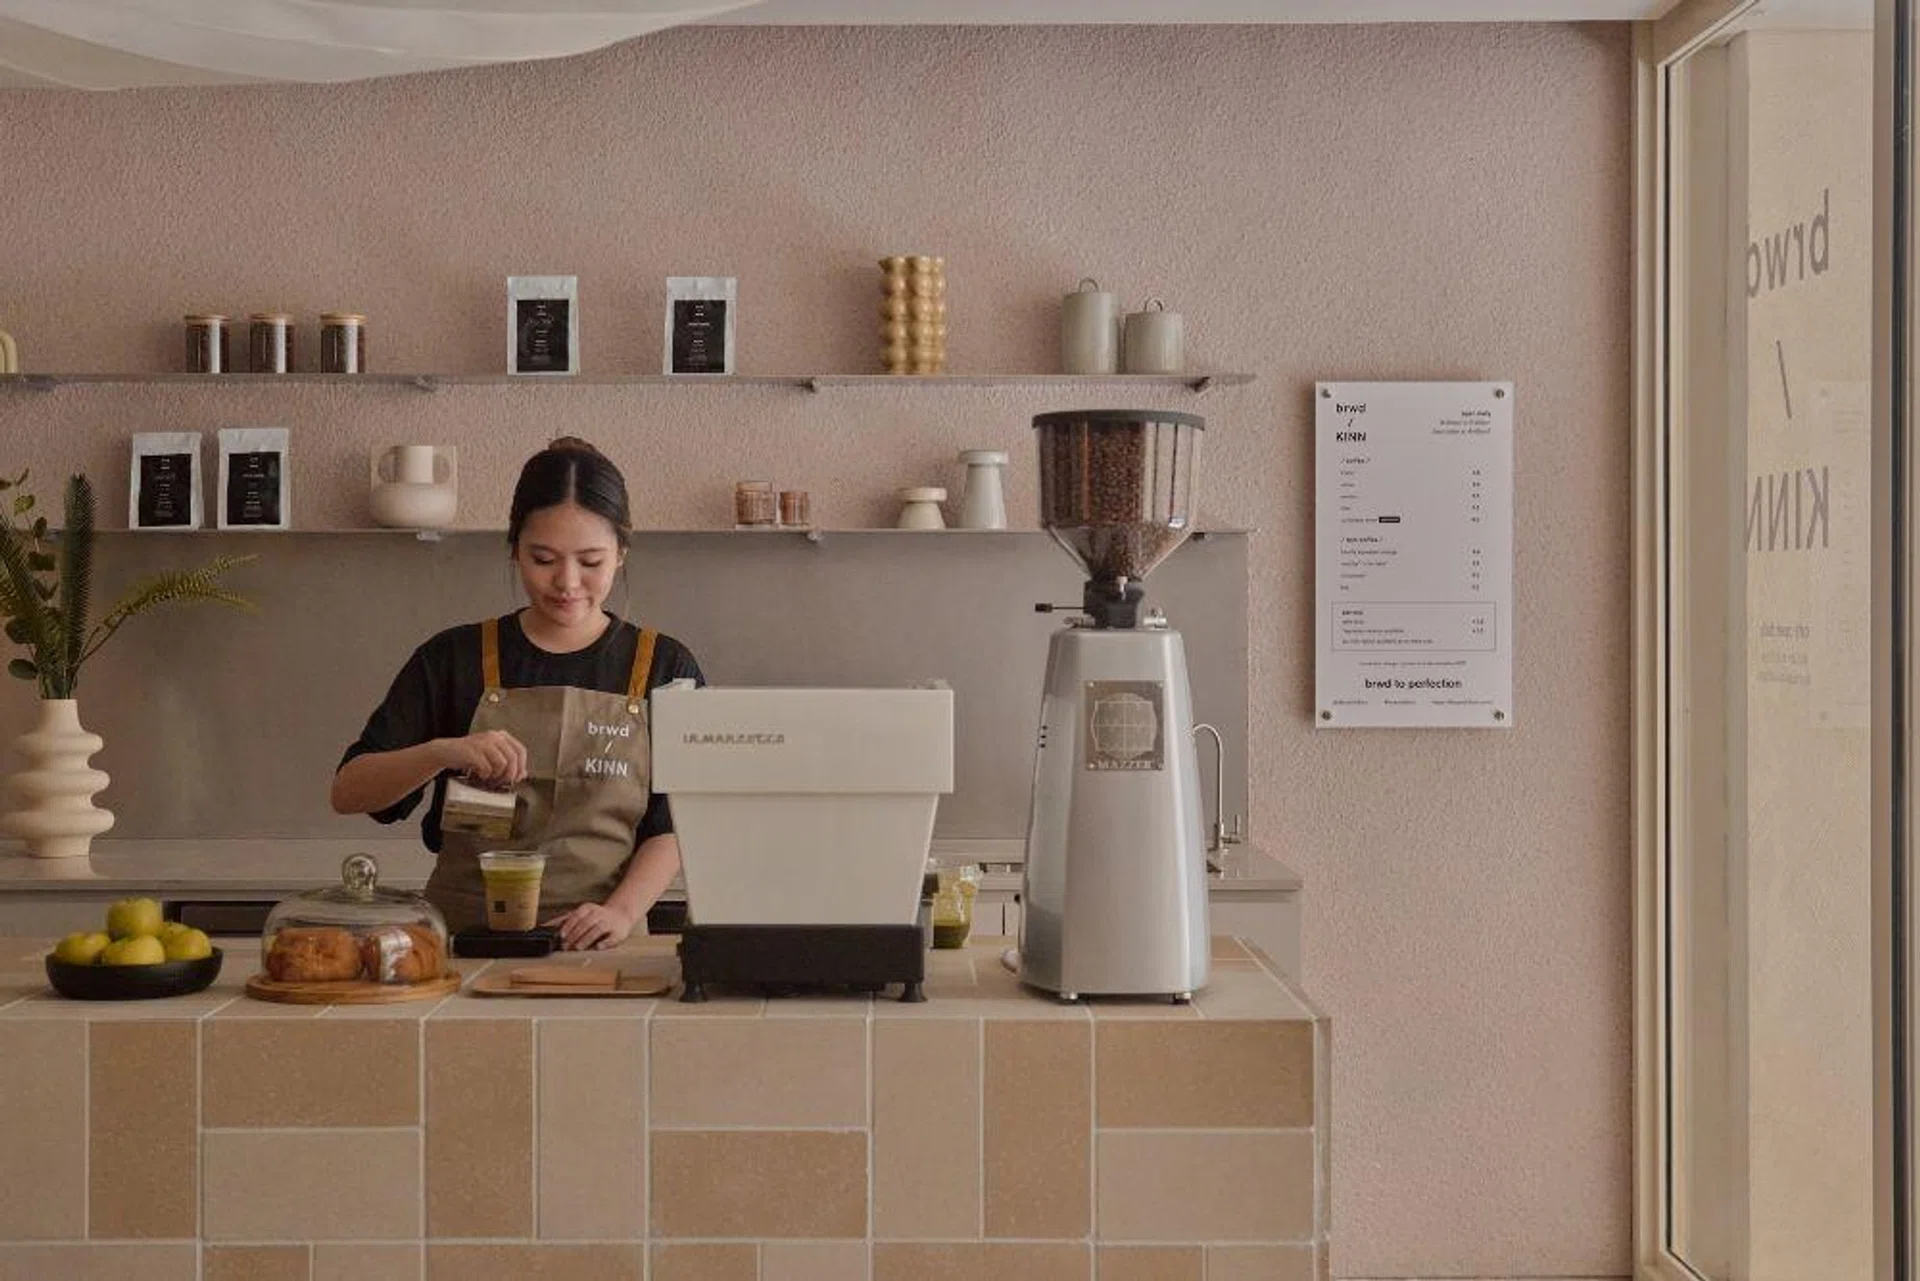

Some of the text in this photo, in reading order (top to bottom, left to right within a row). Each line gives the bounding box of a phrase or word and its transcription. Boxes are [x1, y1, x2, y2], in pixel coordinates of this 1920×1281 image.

[1336, 403, 1367, 413] brwd
[1336, 431, 1367, 442] KINN
[1365, 677, 1462, 691] brwd to perfection
[588, 721, 630, 737] brwd
[585, 758, 628, 777] KINN
